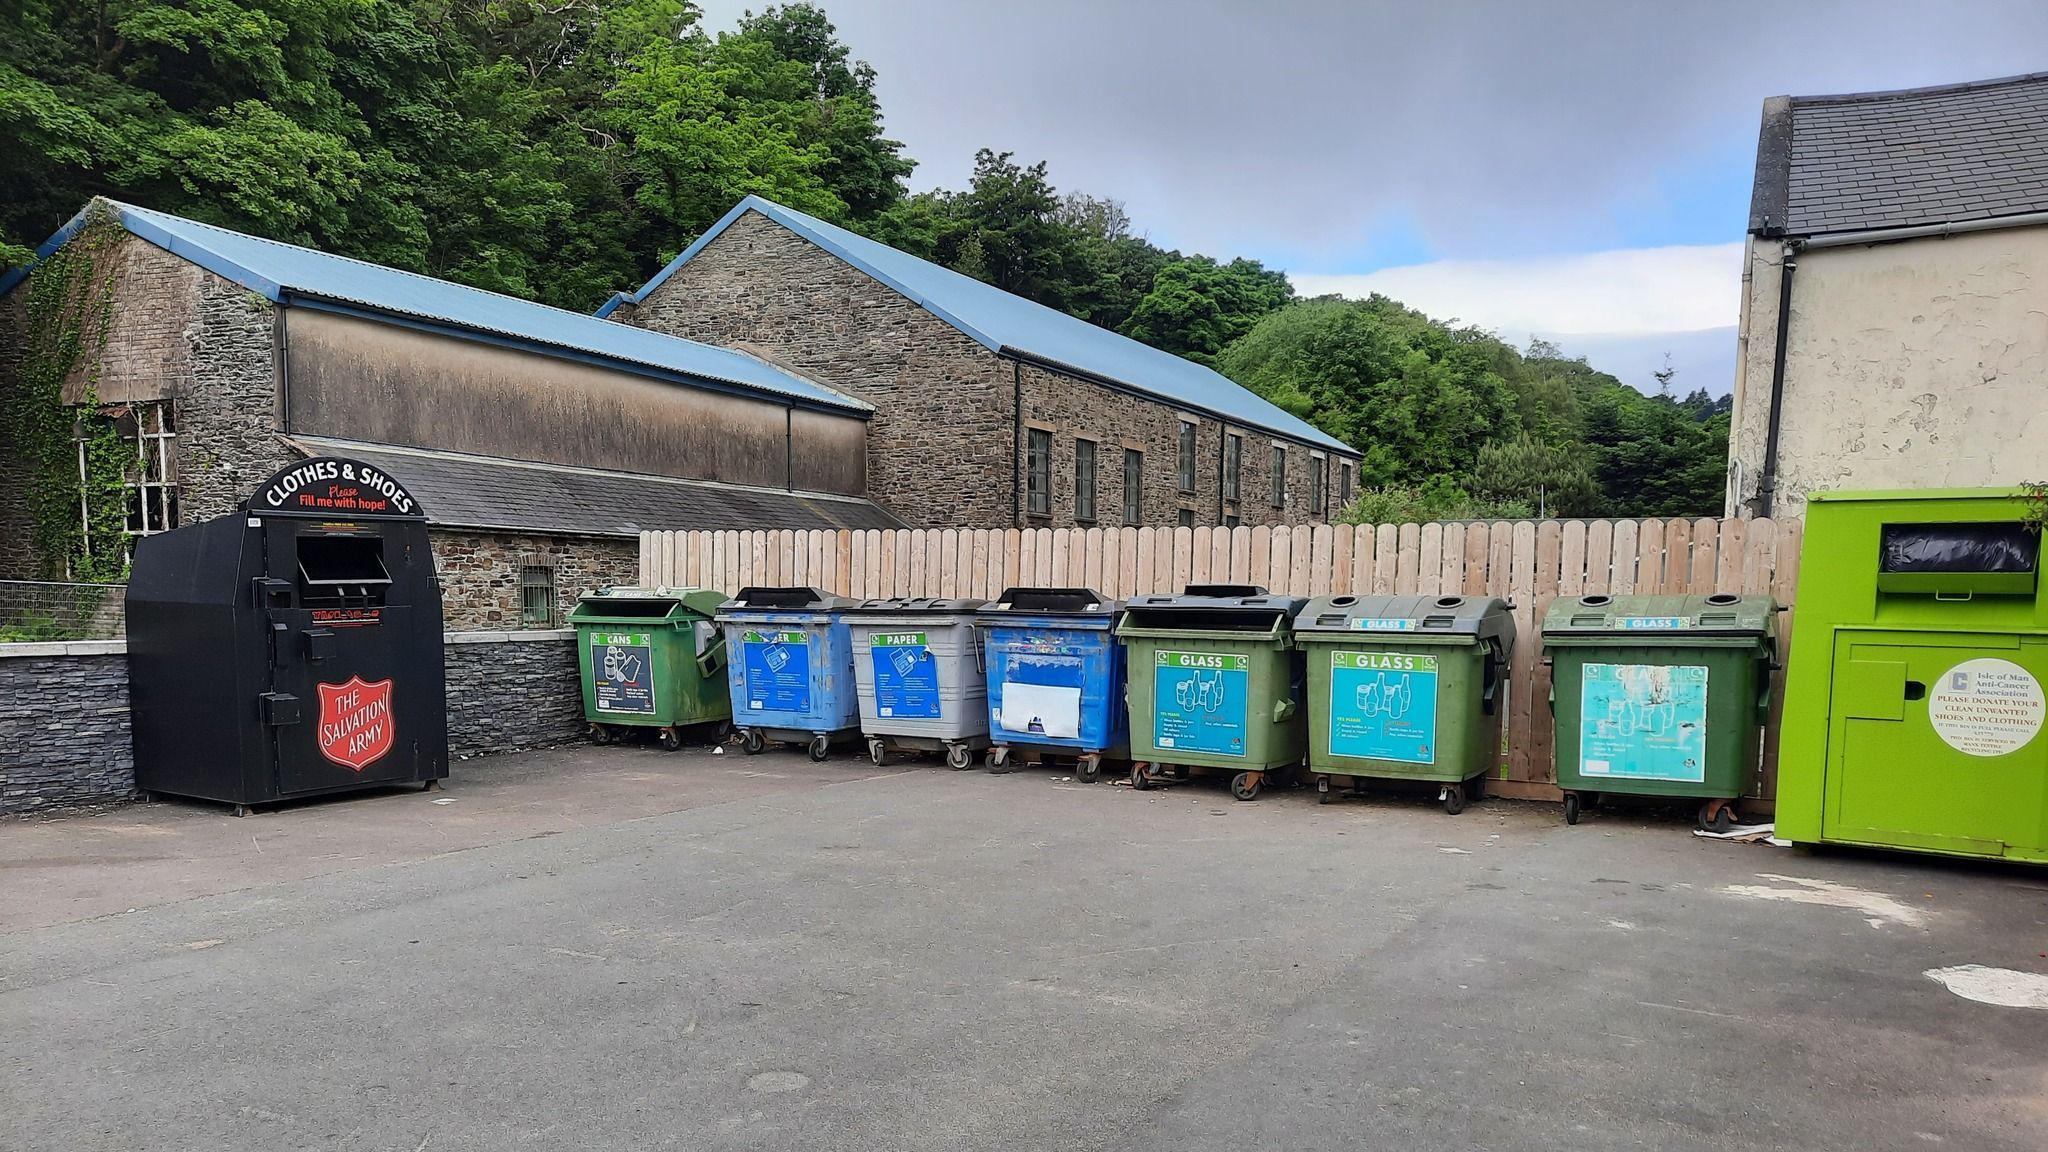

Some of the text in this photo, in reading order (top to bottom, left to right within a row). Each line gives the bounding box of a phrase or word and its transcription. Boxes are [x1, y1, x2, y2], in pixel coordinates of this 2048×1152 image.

[266, 461, 414, 513] CLOTHES & SHOES
[328, 485, 359, 498] Please
[300, 494, 386, 512] Fill me with hope!
[1366, 620, 1401, 629] GLASS
[1632, 618, 1672, 628] GLASS
[607, 635, 632, 645] CANS
[887, 635, 917, 645] PAPER
[1180, 655, 1223, 667] GLASS
[1355, 654, 1414, 670] GLASS
[1978, 672, 1994, 680] Isle
[1976, 681, 2030, 690] Anti-Cancer
[1975, 688, 2028, 698] Association
[335, 688, 360, 714] THE
[1938, 695, 2039, 708] PLEASE DONATE YOUR
[1945, 705, 2028, 716] CLEAN UNWANTED
[323, 693, 386, 747] SALVATION
[1967, 715, 1986, 723] AND
[1989, 717, 2037, 727] CLOTHING
[349, 719, 383, 757] ARMY
